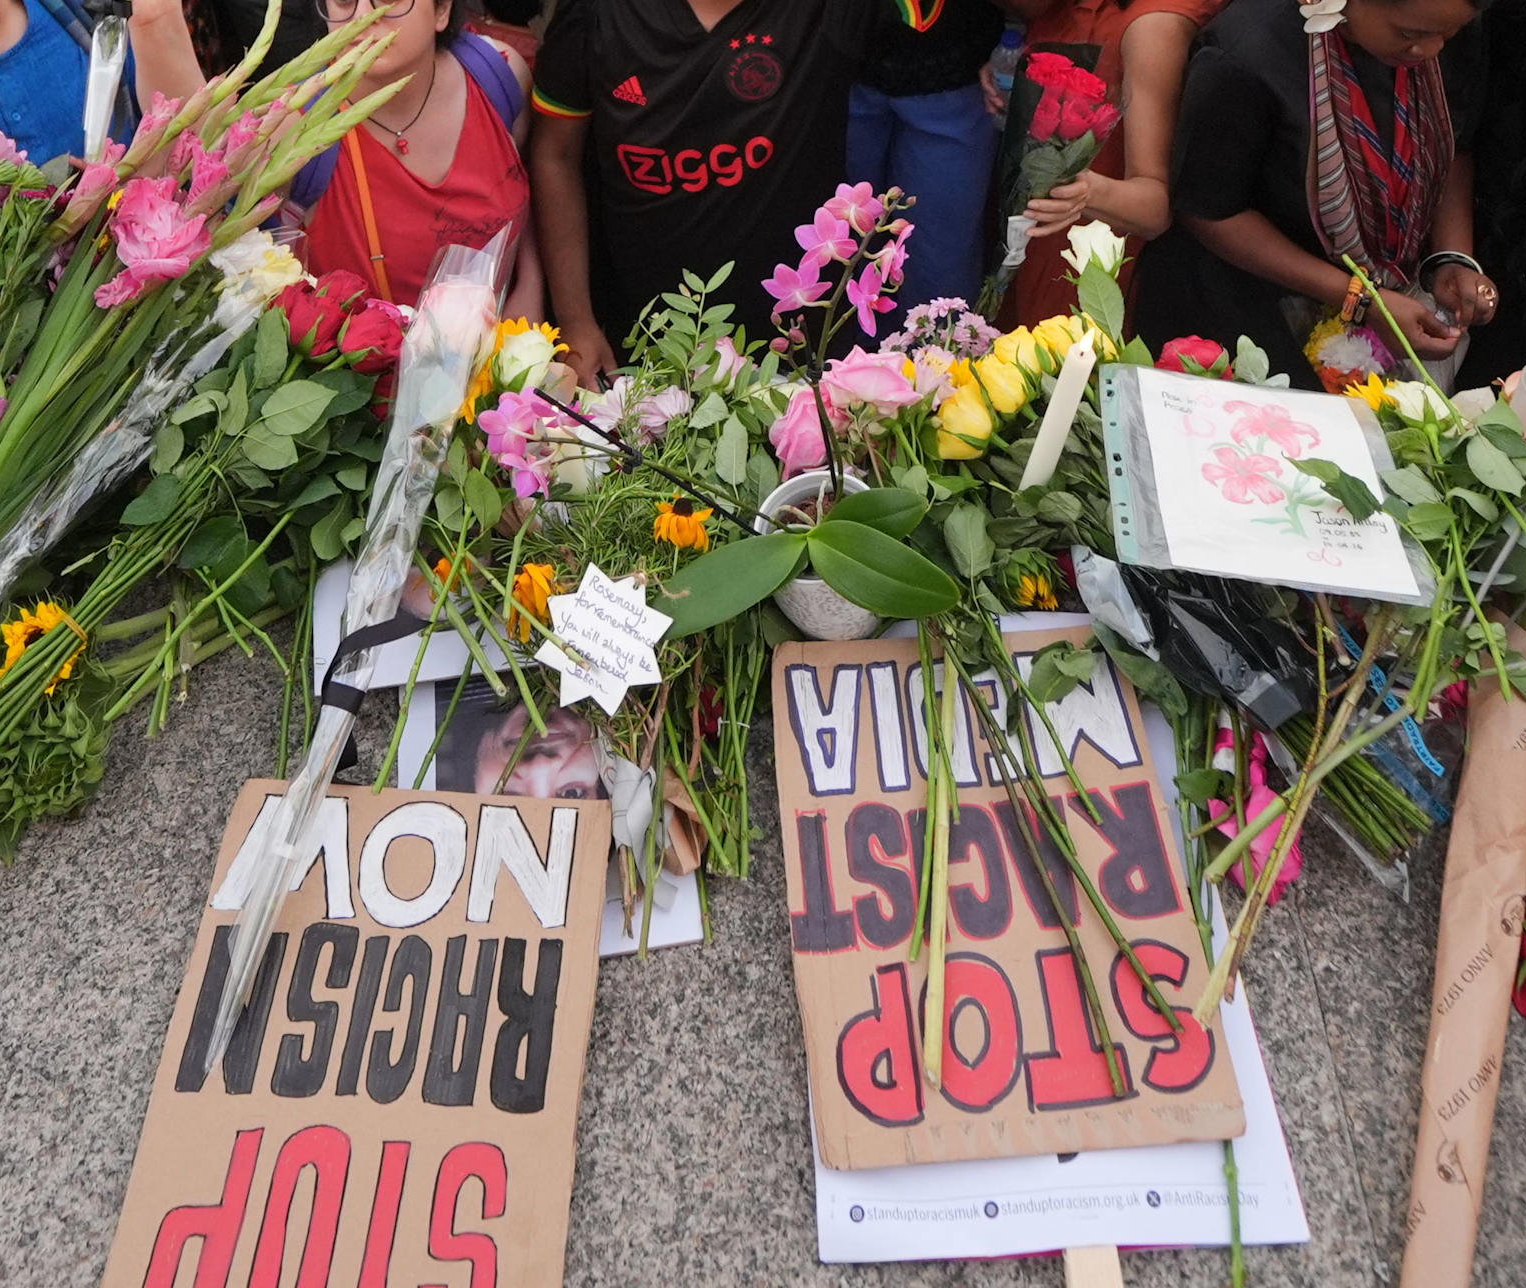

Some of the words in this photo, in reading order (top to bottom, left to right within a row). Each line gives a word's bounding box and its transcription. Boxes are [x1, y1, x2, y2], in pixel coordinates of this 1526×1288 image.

[612, 87, 648, 107] adidas
[557, 612, 578, 634] You
[582, 628, 600, 645] will
[639, 656, 653, 673] be
[1403, 716, 1443, 773] FAIRTRAD
[210, 795, 579, 929] NOW
[1460, 943, 1495, 983] ANNO
[175, 923, 563, 1114] RACISM
[1437, 983, 1463, 1018] 1973
[837, 939, 1215, 1128] STOP
[1438, 1089, 1470, 1122] 1973
[867, 1204, 980, 1224] standuptoracismuk
[1000, 1192, 1141, 1217] standuptoracism.org.uk
[1164, 1190, 1260, 1212] @AntiRacisDay
[1404, 1200, 1427, 1245] ANN
